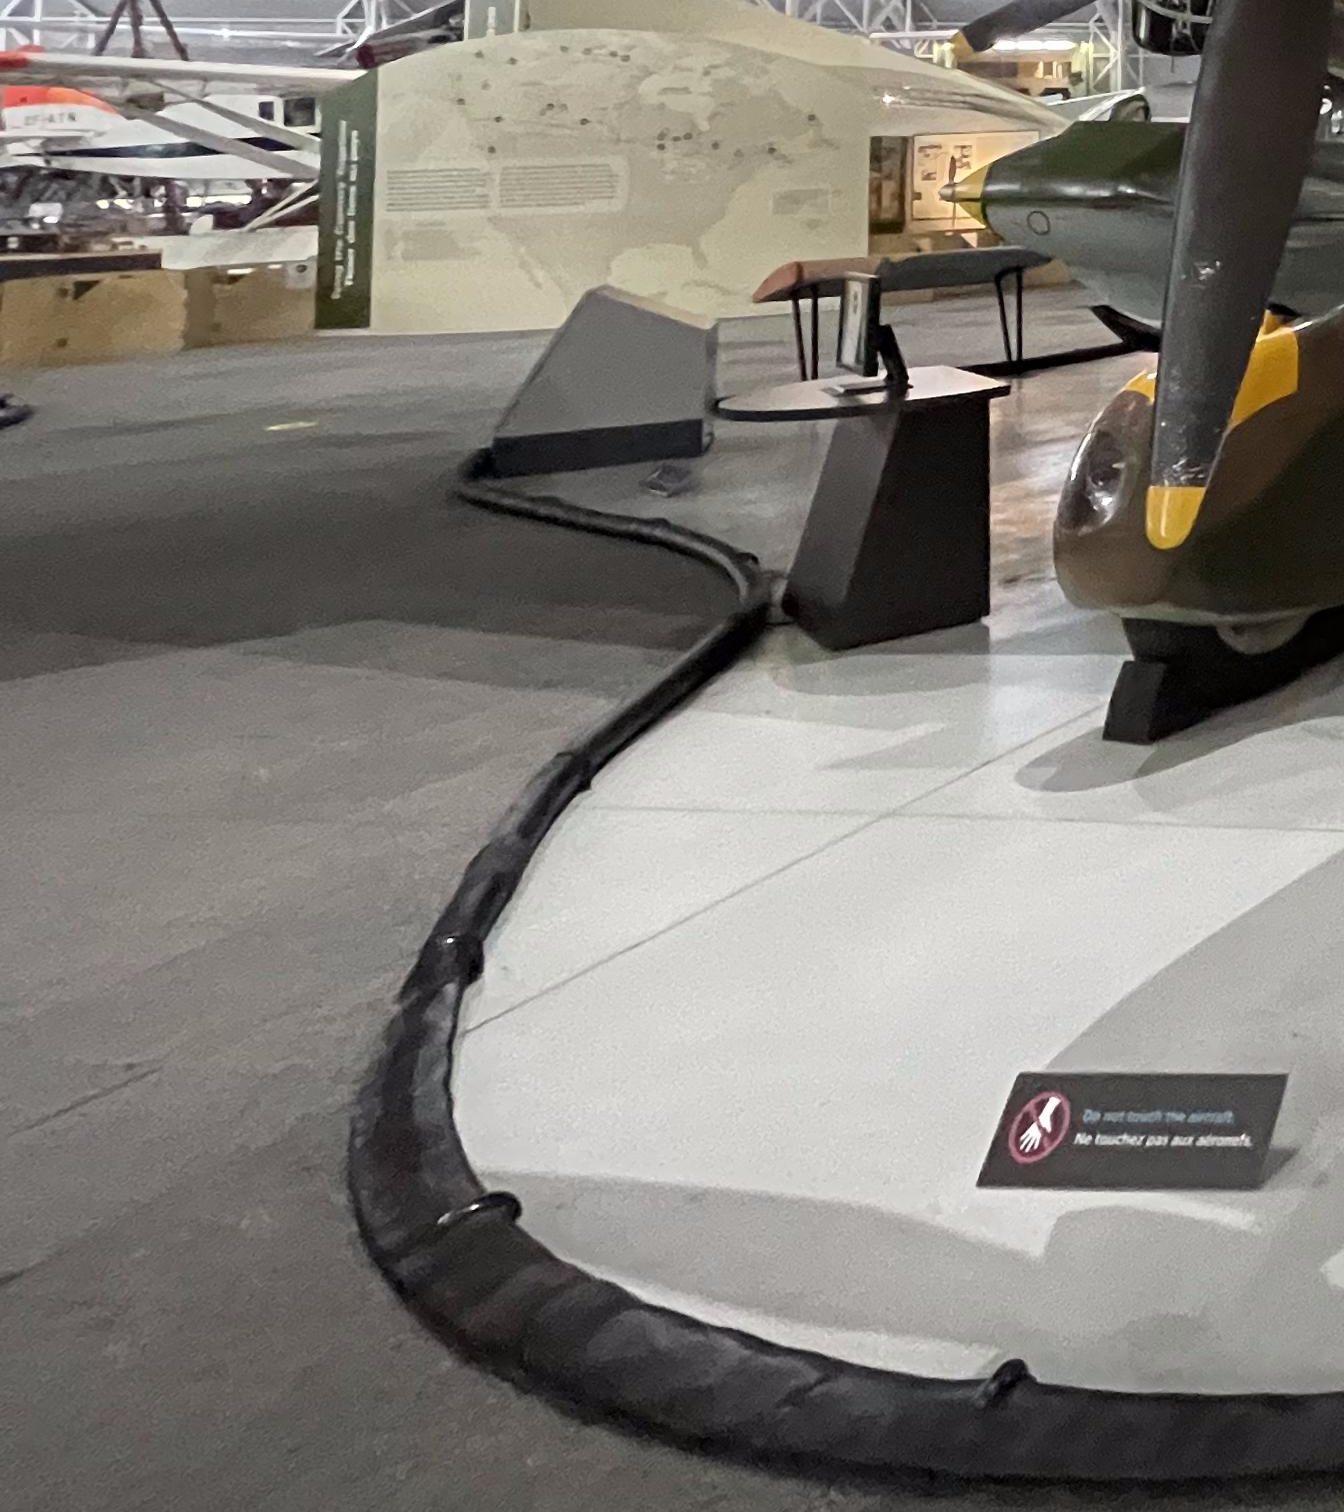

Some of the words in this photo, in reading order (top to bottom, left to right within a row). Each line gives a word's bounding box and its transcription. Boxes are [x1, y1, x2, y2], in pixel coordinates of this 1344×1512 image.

[1082, 1109, 1101, 1124] Do
[1102, 1110, 1126, 1123] not
[1126, 1110, 1162, 1123] touch
[1073, 1132, 1093, 1146] Ne
[1094, 1132, 1146, 1146] touchez
[1145, 1135, 1169, 1148] pas
[1170, 1135, 1194, 1147] aux
